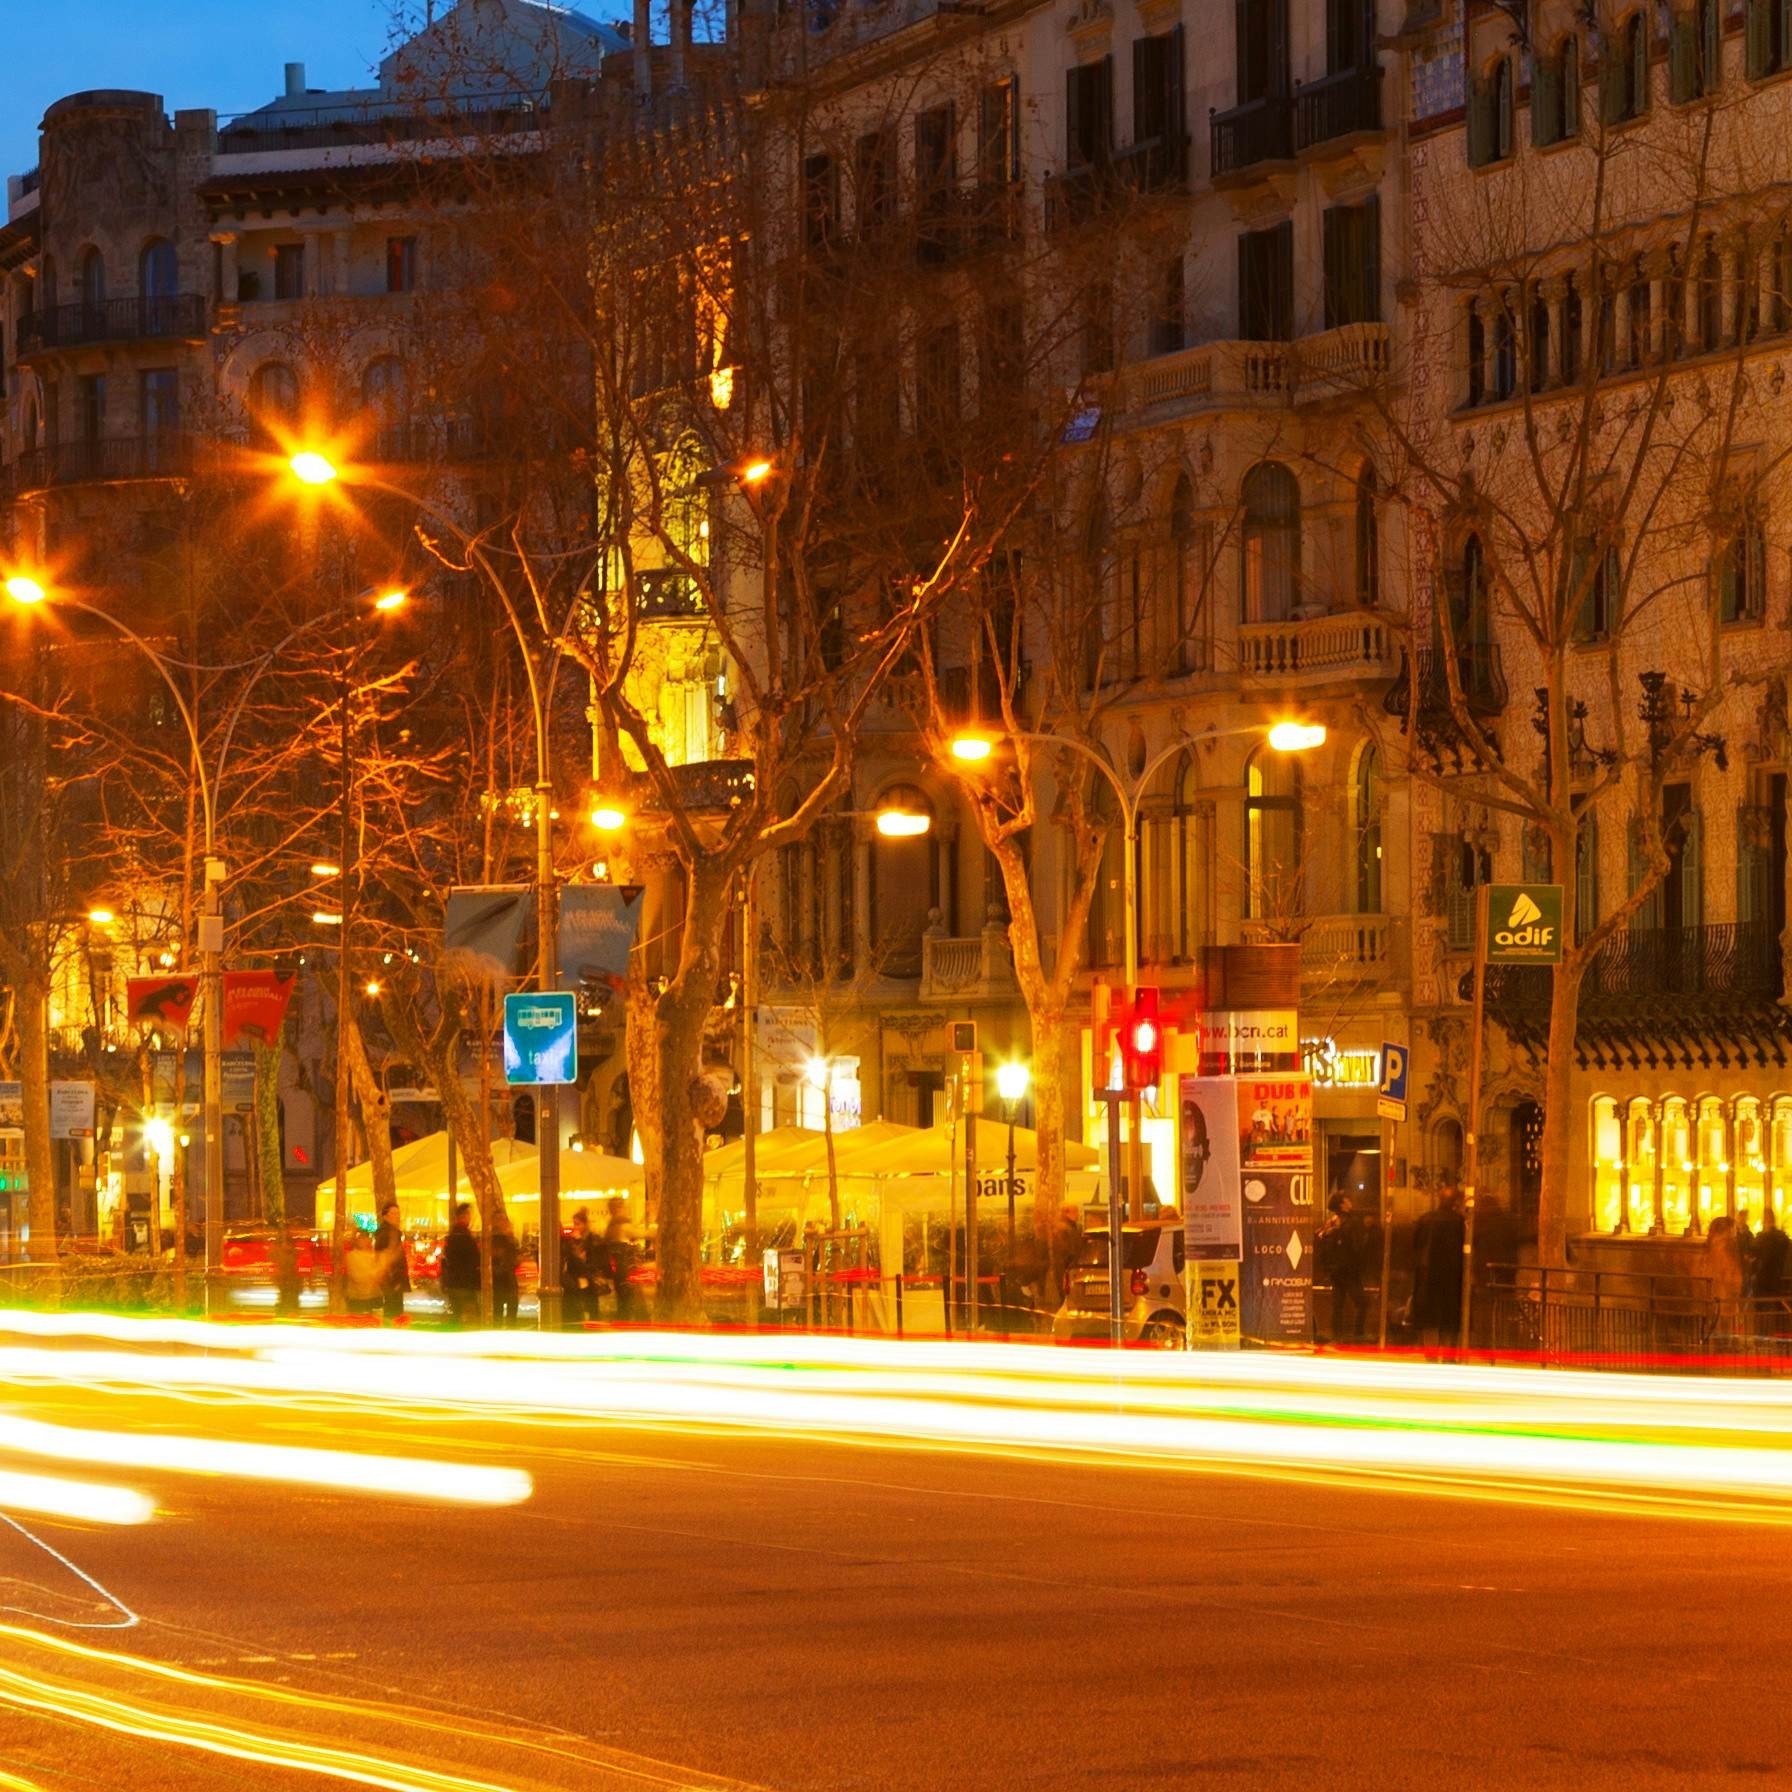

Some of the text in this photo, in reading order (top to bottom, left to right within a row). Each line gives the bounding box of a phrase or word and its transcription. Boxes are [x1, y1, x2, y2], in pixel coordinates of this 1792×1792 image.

[1495, 926, 1554, 945] adif
[1382, 1049, 1403, 1092] P
[1254, 1084, 1294, 1100] DUB
[1254, 1246, 1282, 1254] LOCO
[1201, 1280, 1236, 1309] FX
